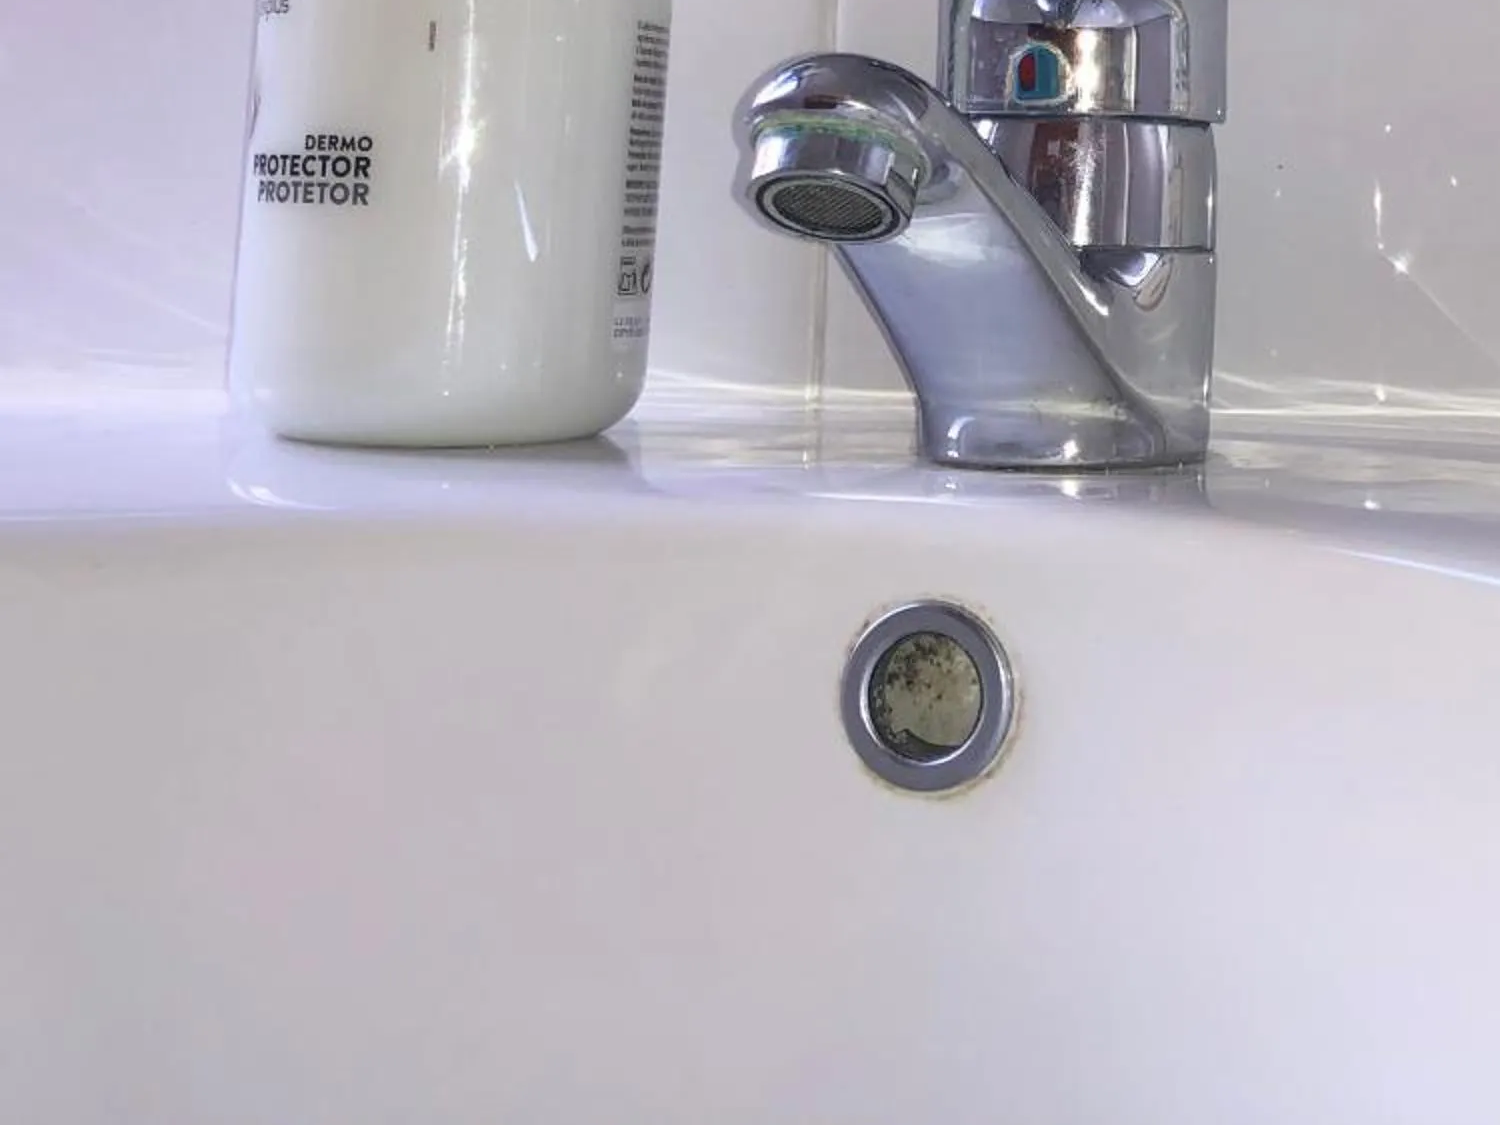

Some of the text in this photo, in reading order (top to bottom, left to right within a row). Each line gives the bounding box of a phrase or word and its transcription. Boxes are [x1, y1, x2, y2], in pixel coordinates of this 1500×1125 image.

[305, 134, 373, 152] DERMO
[253, 154, 371, 178] PROTECTOR
[257, 180, 369, 206] PROTETOR
